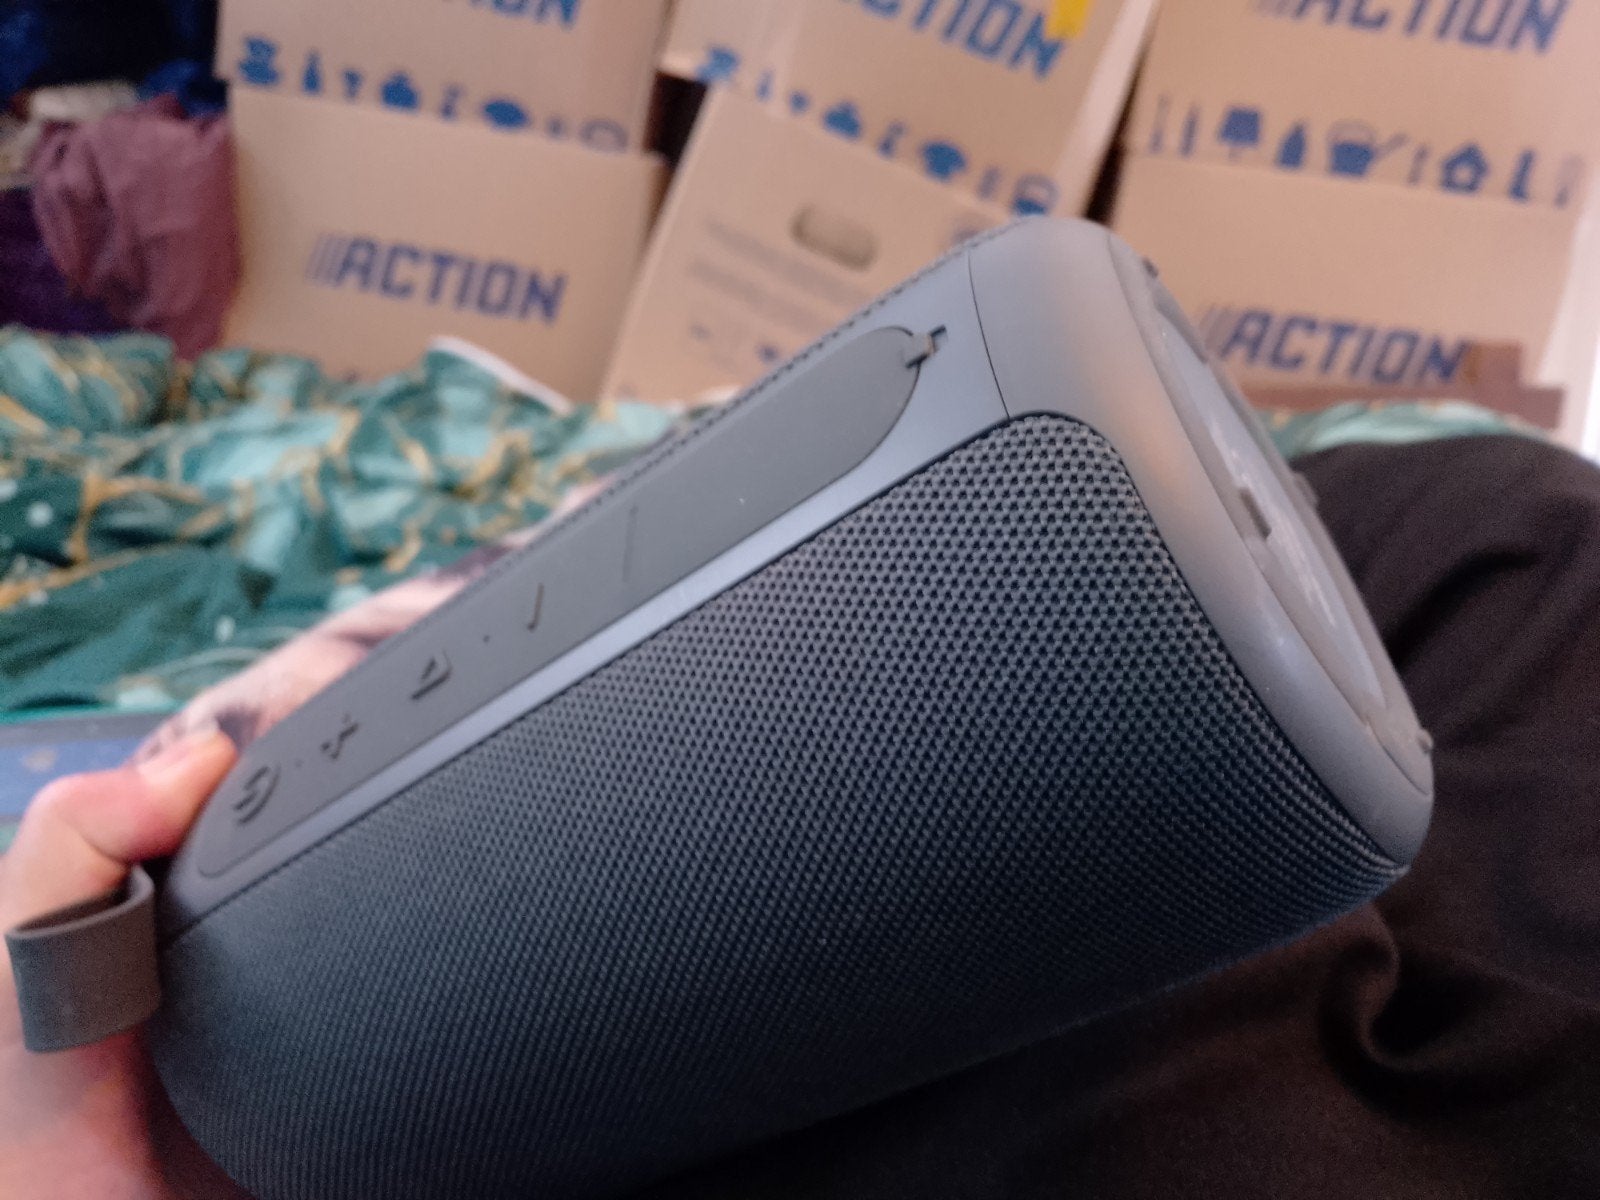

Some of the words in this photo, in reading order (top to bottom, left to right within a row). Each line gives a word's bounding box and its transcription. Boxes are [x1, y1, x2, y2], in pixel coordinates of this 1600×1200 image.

[860, 0, 1064, 81] TION
[332, 237, 567, 325] ACTION
[1219, 309, 1470, 386] ACTION
